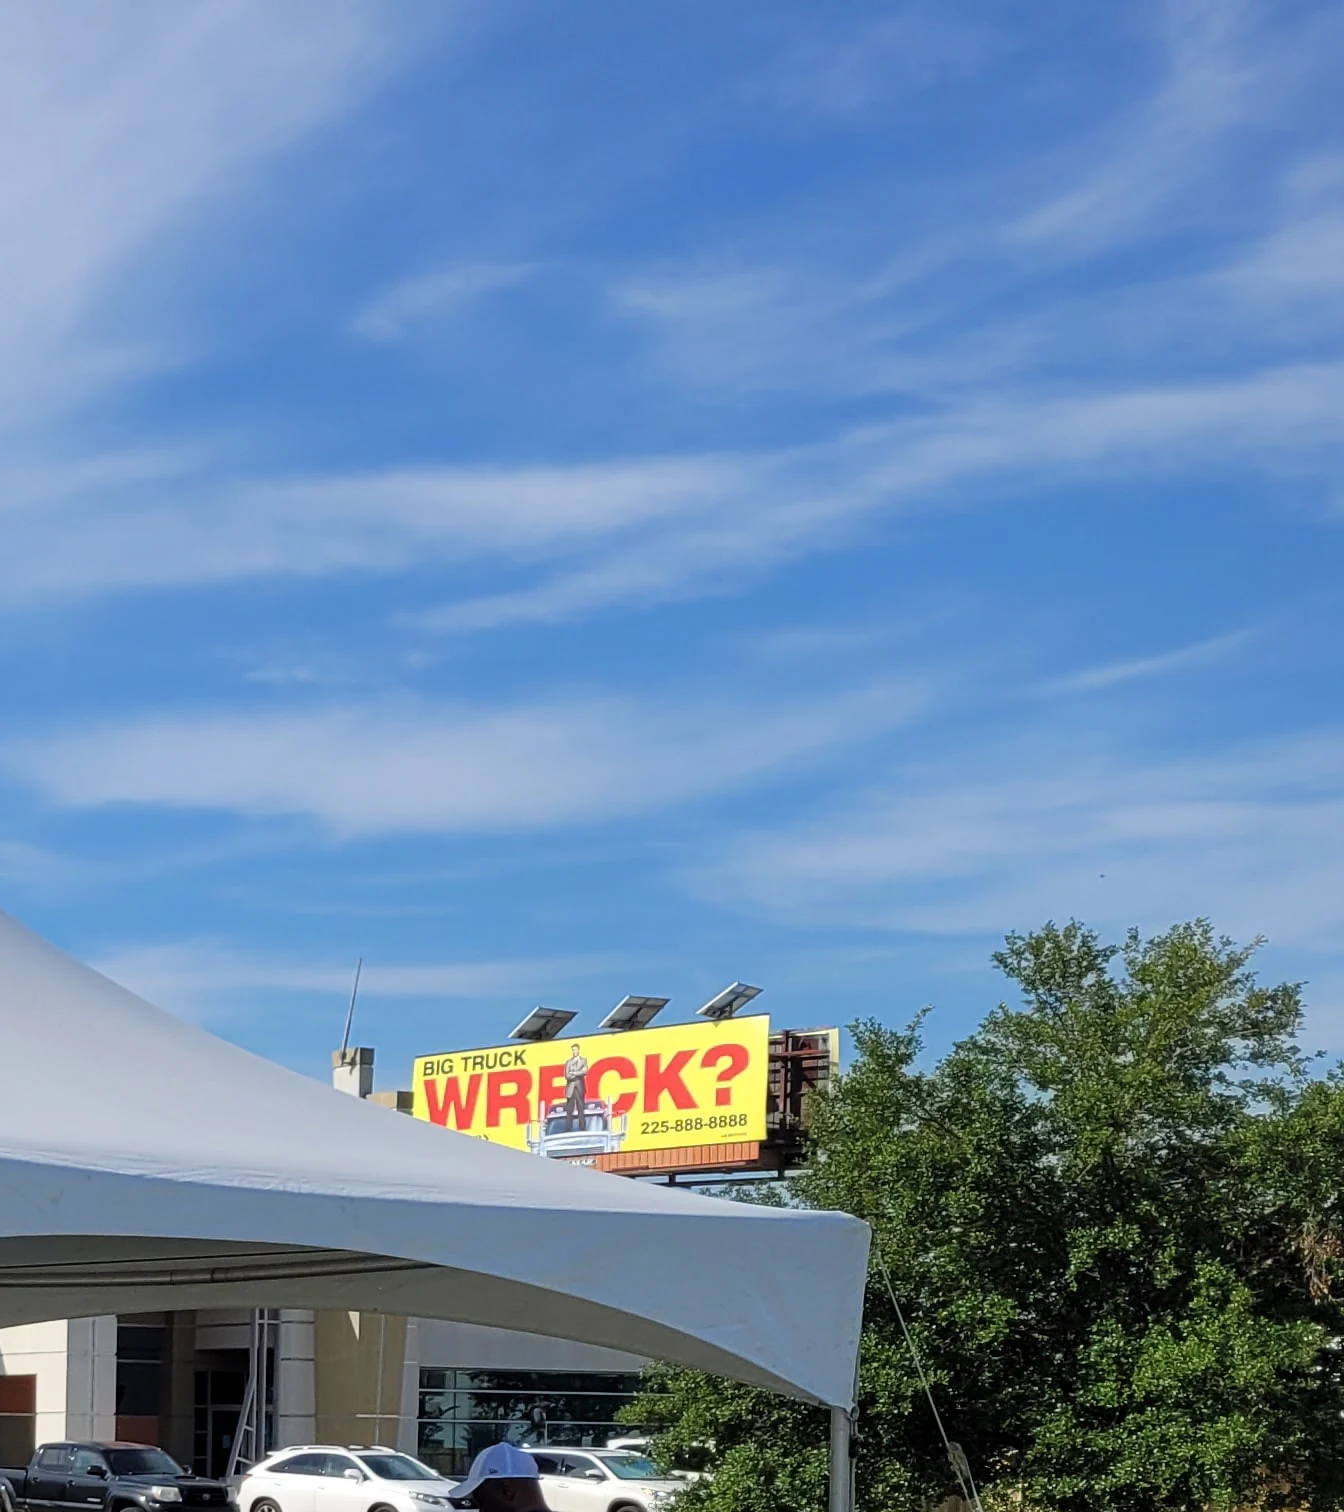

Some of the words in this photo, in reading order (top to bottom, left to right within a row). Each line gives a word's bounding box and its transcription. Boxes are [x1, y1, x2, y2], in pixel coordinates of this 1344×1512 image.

[423, 1058, 454, 1077] BIG
[461, 1050, 527, 1072] TRUCK
[640, 1113, 748, 1135] 225-888-8888
